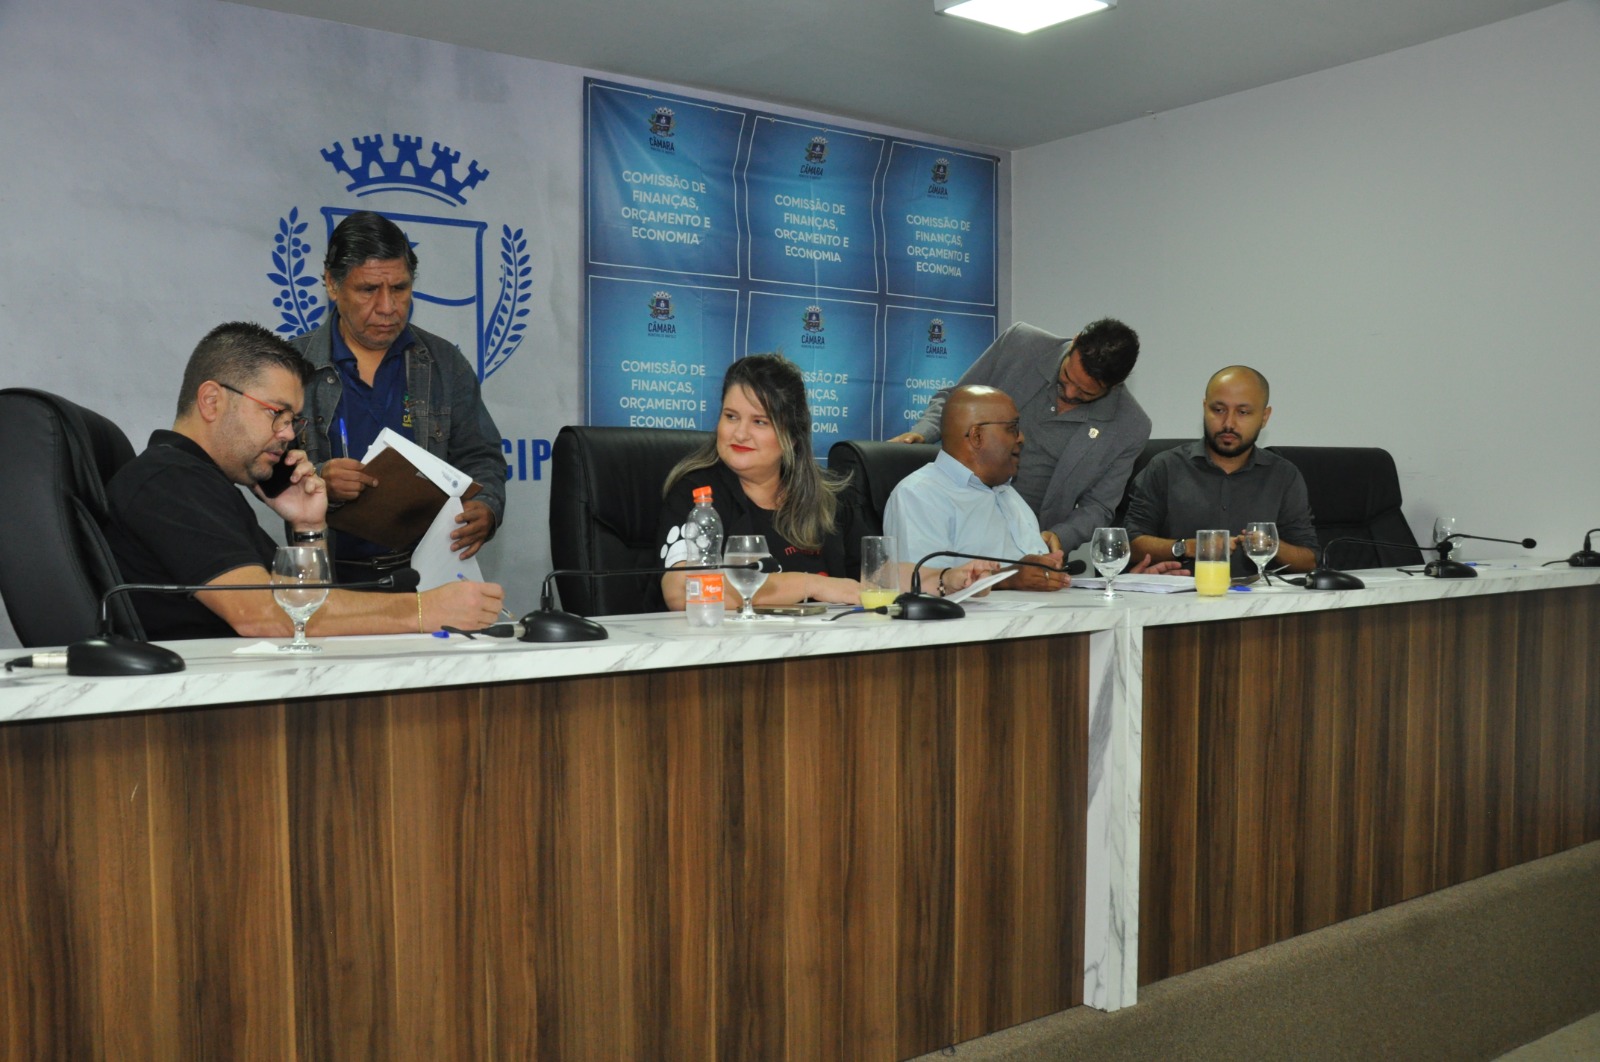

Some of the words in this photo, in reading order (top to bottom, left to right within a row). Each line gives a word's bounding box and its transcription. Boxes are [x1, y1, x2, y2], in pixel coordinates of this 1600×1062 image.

[622, 170, 689, 190] COMISSÃO
[692, 181, 707, 194] DE
[632, 189, 699, 211] FINANÇAS,
[774, 194, 830, 213] COMISSÃO
[832, 203, 846, 216] DE
[621, 206, 701, 227] ORÇAMENTO
[704, 216, 711, 229] E
[784, 212, 838, 232] FINANÇAS,
[906, 214, 959, 230] COMISSÃO
[960, 220, 971, 232] DE
[632, 226, 700, 245] ECONOMIA
[774, 228, 841, 247] ORÇAMENTO
[843, 236, 849, 248] E
[915, 230, 963, 248] FINANÇAS,
[785, 245, 842, 263] ECONOMIA
[906, 245, 963, 262] ORÇAMENTO
[964, 252, 970, 263] E
[916, 261, 962, 278] ECONOMIA
[621, 360, 687, 375] COMISSÃO
[690, 364, 706, 376] DE
[631, 379, 695, 396] FINANÇAS,
[834, 373, 848, 384] DE
[619, 396, 697, 412] ORÇAMENTO
[700, 400, 707, 412] E
[806, 388, 839, 402] NÇAS,
[842, 406, 848, 418] E
[630, 415, 696, 429] ECONOMIA
